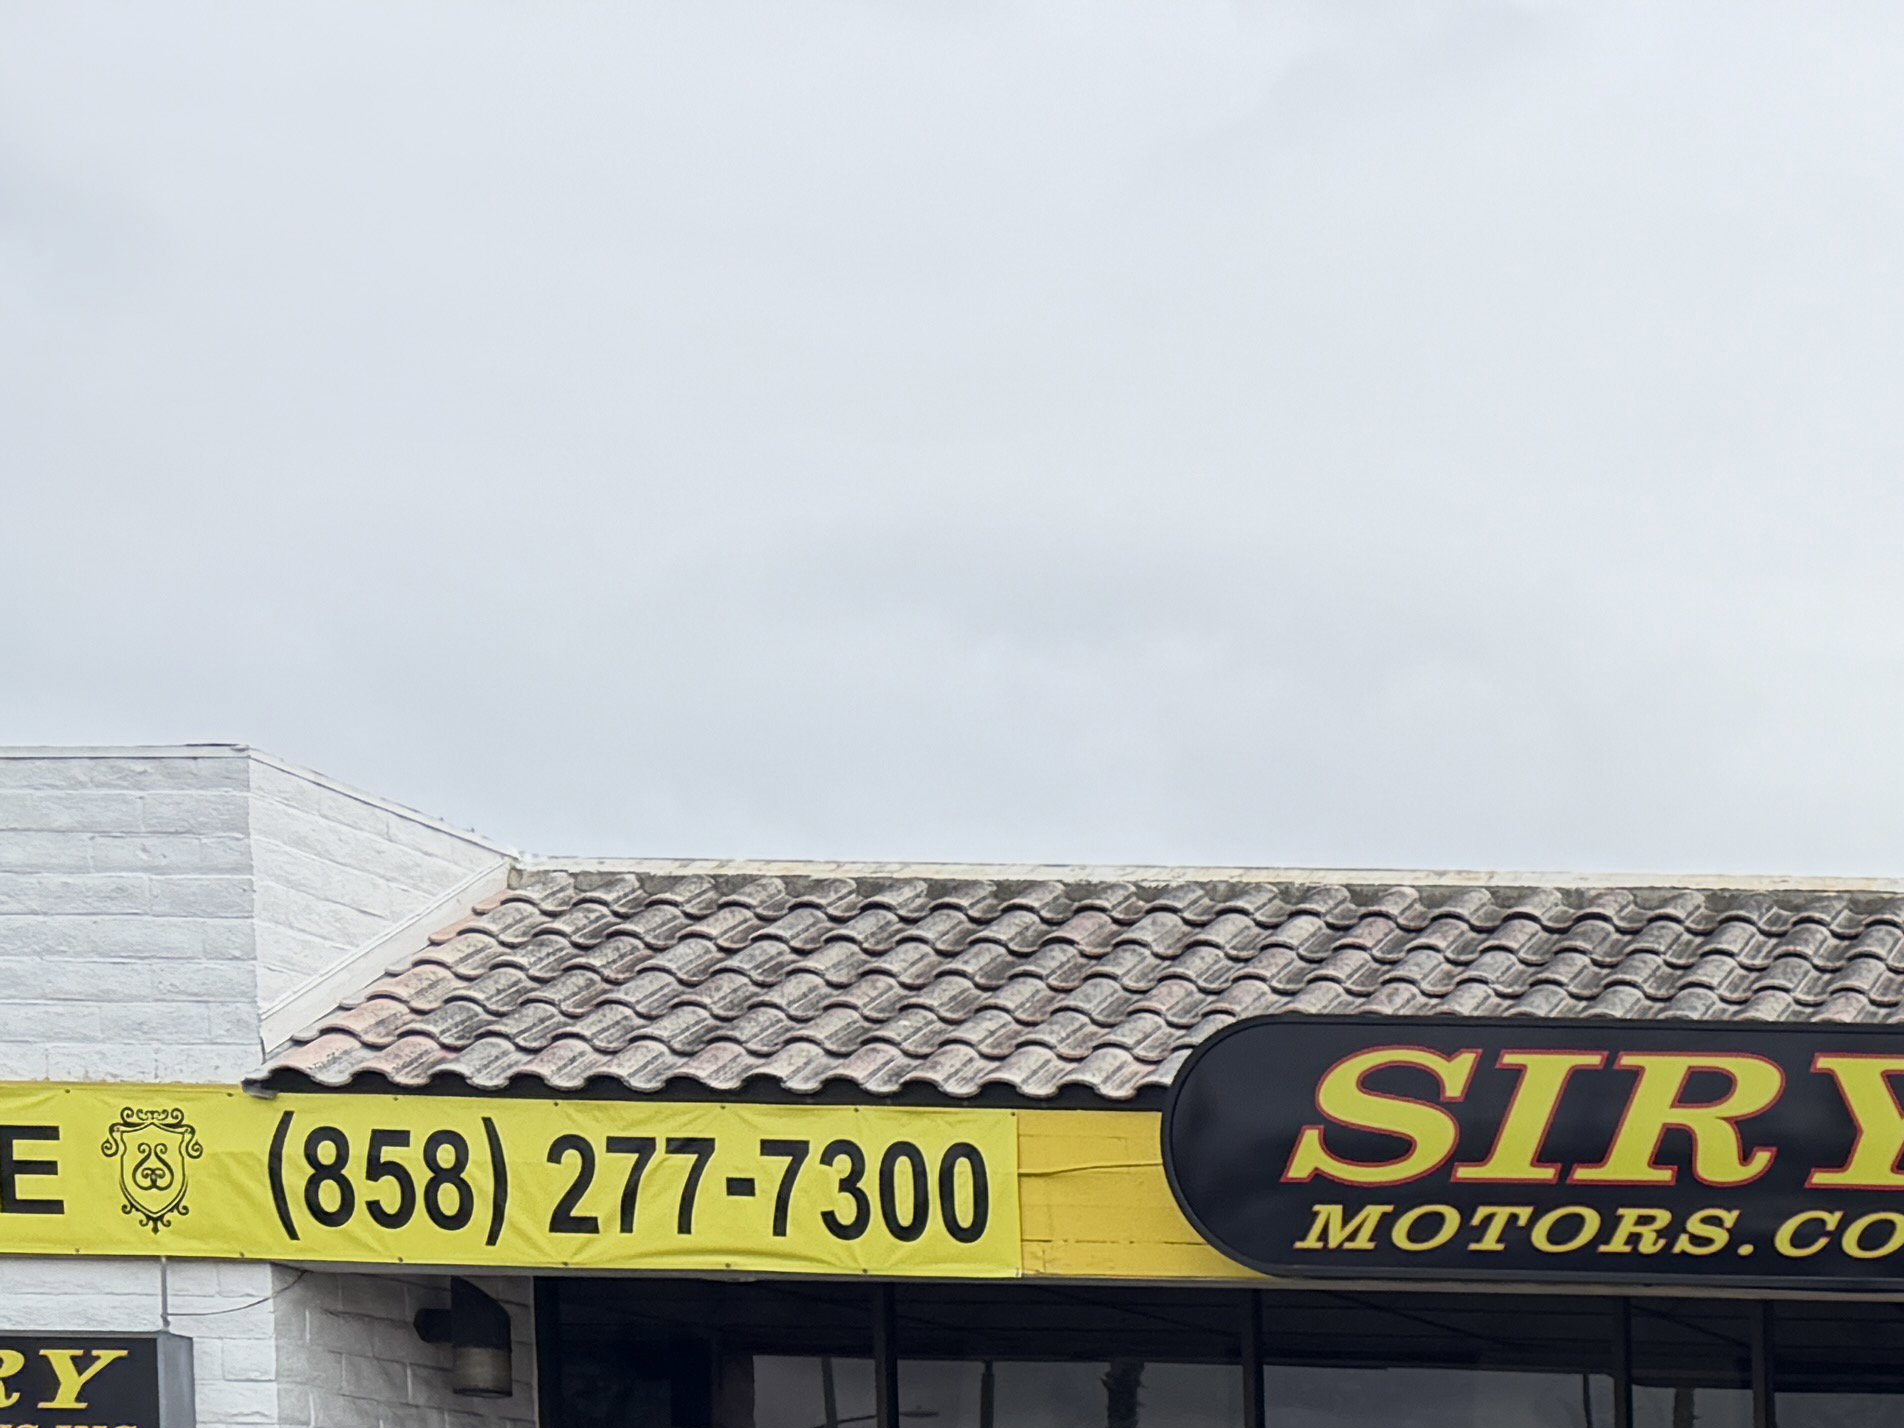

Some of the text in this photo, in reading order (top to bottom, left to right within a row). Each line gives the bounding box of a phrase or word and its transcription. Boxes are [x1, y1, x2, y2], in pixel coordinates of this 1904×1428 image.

[0, 1125, 65, 1214] E
[268, 1110, 991, 1246] (858) 277-7300
